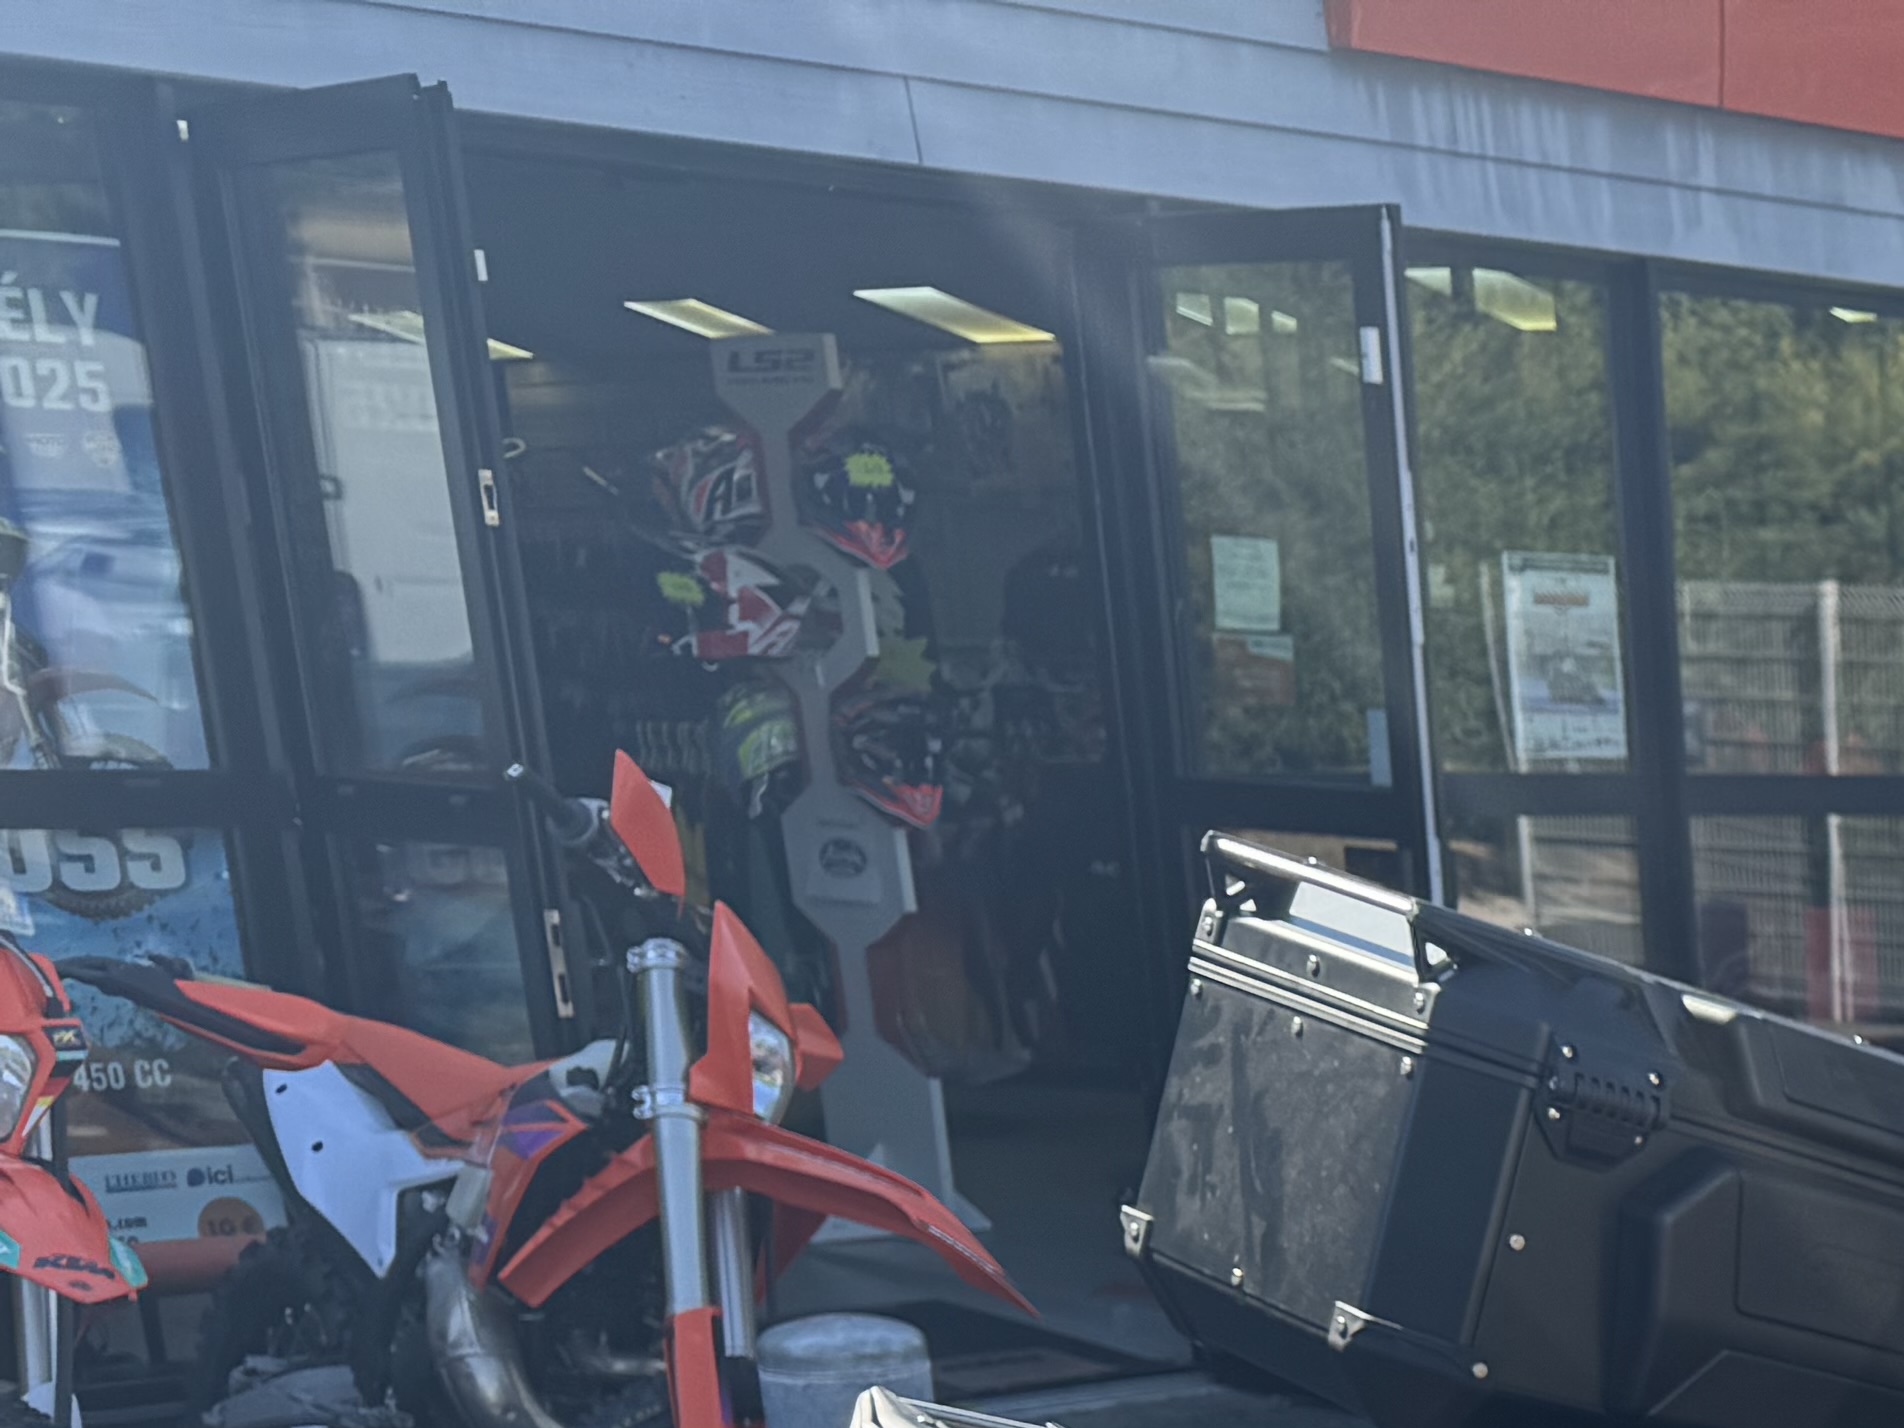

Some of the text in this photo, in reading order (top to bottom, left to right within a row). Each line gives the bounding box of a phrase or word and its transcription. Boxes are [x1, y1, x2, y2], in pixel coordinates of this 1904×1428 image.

[727, 351, 815, 373] LS2
[72, 1057, 173, 1092] 450 CC
